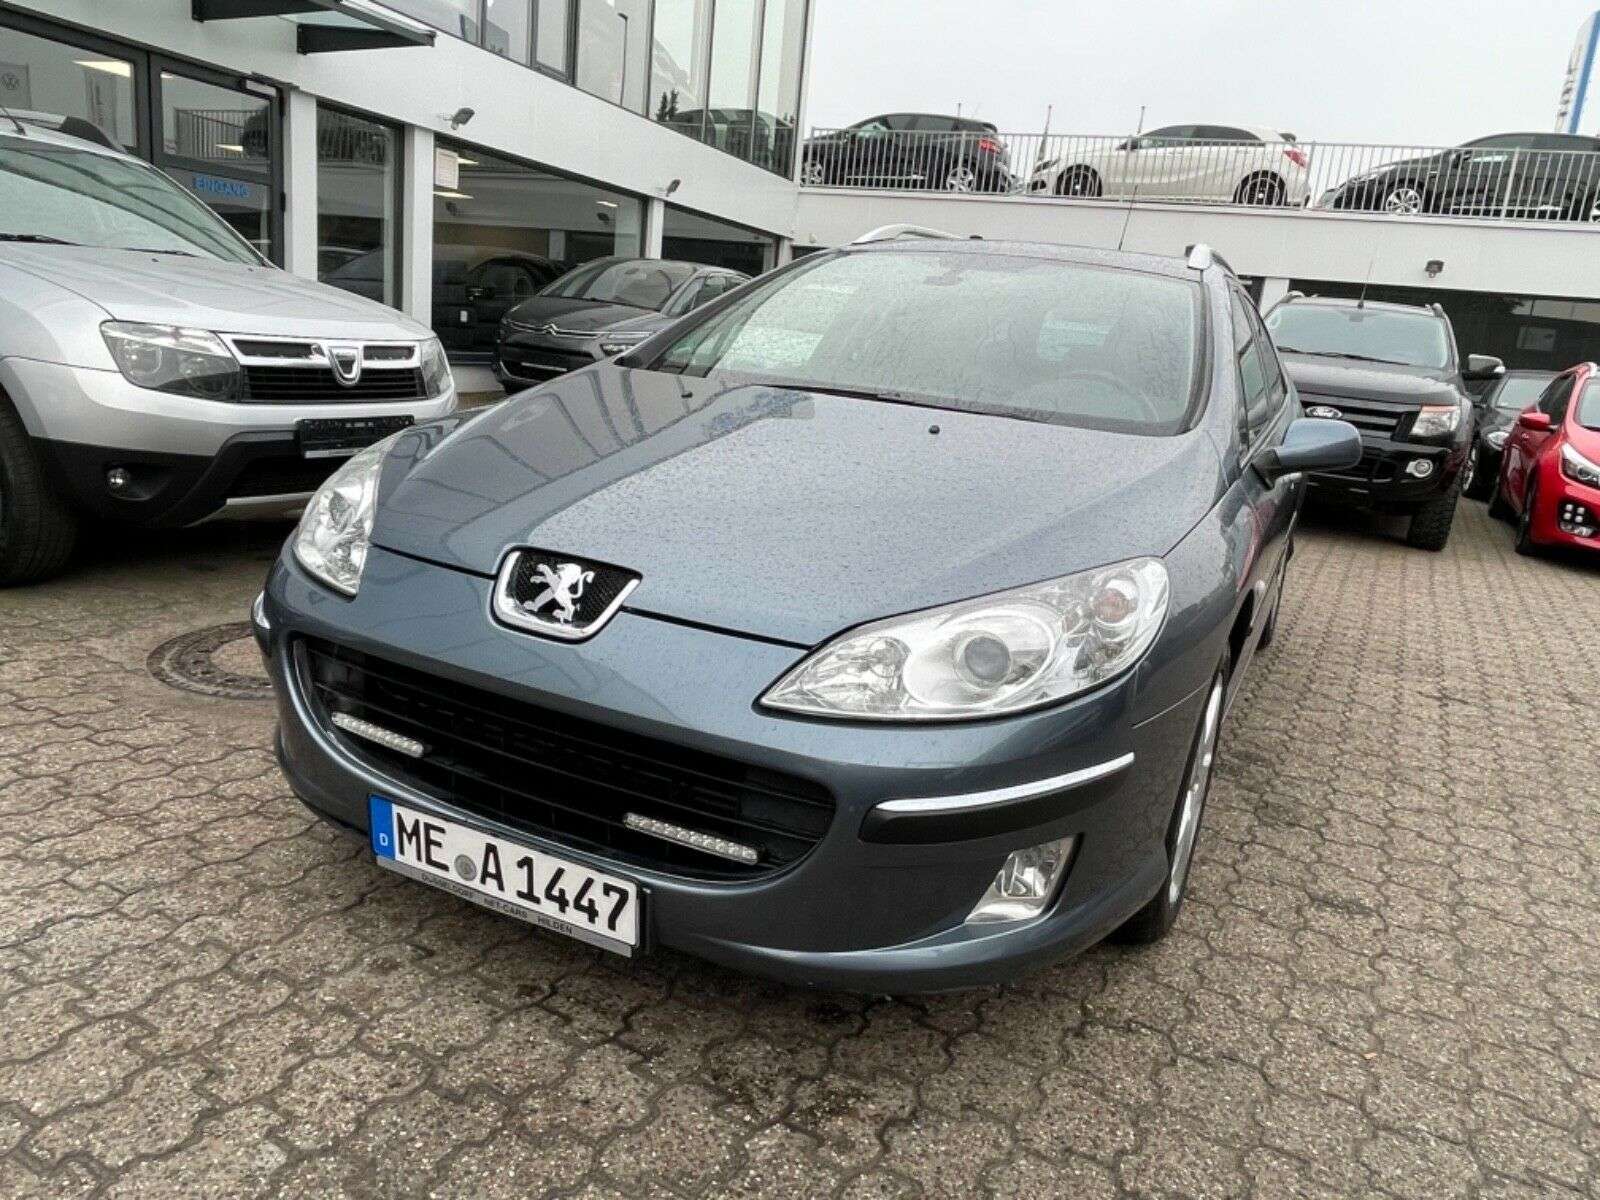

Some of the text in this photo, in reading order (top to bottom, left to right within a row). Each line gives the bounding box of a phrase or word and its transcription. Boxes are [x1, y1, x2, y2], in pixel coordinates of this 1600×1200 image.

[379, 832, 388, 846] D
[396, 812, 450, 872] ME
[537, 915, 573, 935] HILDEN
